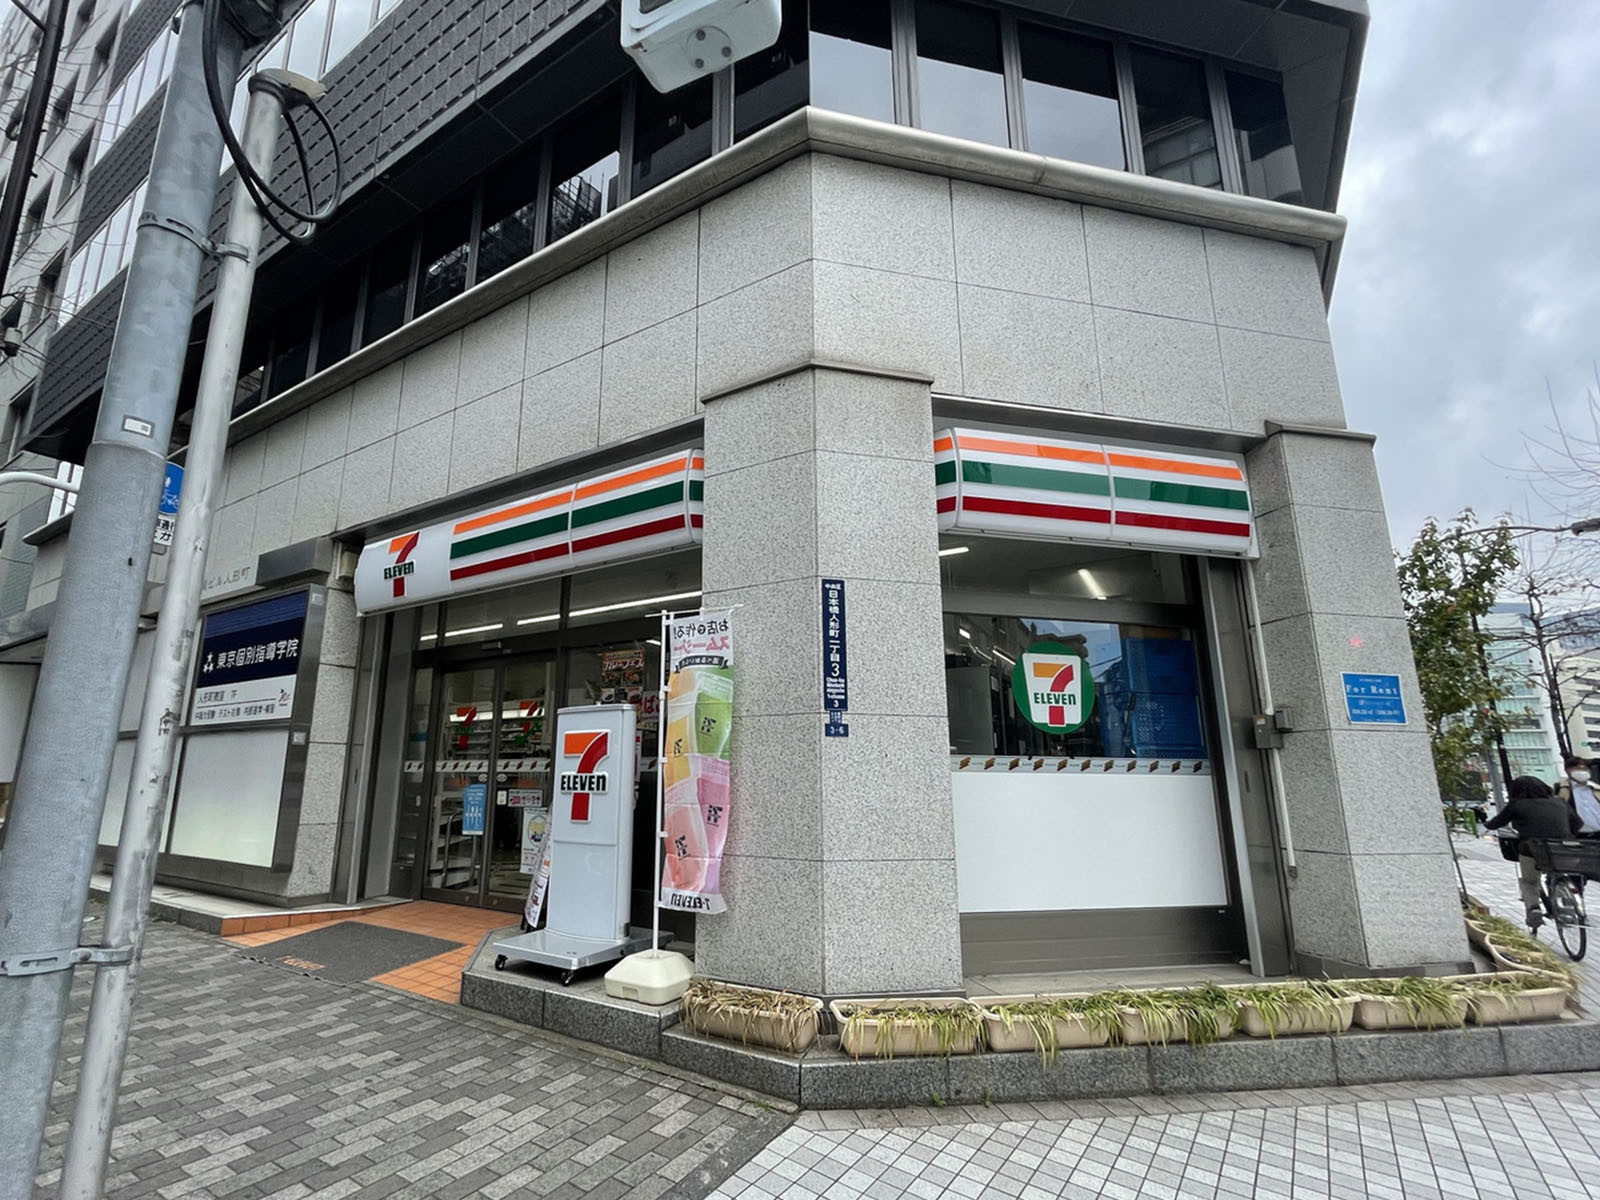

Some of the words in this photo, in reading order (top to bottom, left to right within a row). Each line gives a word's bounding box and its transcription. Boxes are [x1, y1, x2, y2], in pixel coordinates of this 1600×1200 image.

[203, 566, 250, 590] ビル人形町
[389, 531, 420, 597] 7
[216, 638, 299, 669] 東京個別指導学院
[1033, 662, 1074, 725] 7
[564, 732, 608, 820] 7
